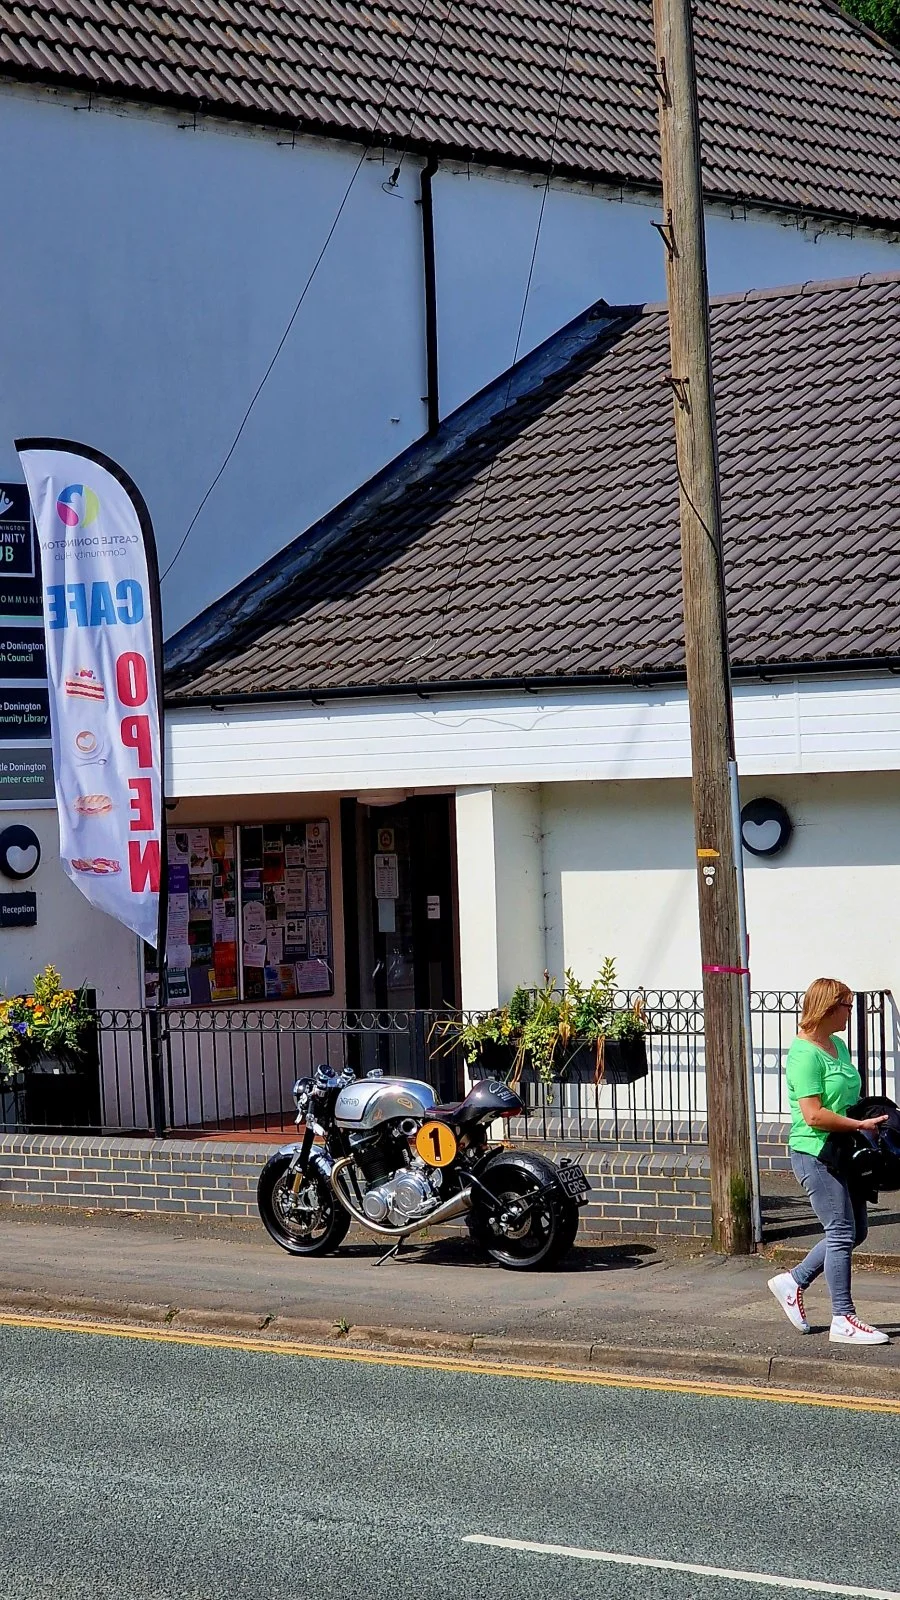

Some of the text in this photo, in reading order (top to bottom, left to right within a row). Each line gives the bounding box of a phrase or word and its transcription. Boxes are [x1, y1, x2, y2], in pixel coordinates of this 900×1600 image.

[6, 641, 44, 653] Donington
[7, 653, 34, 662] Council
[3, 701, 42, 712] Donington
[23, 713, 48, 724] Library
[9, 762, 47, 773] Donington
[22, 775, 45, 783] centre
[2, 905, 35, 915] Reception
[429, 1128, 442, 1162] 1
[568, 1179, 587, 1194] GRS
